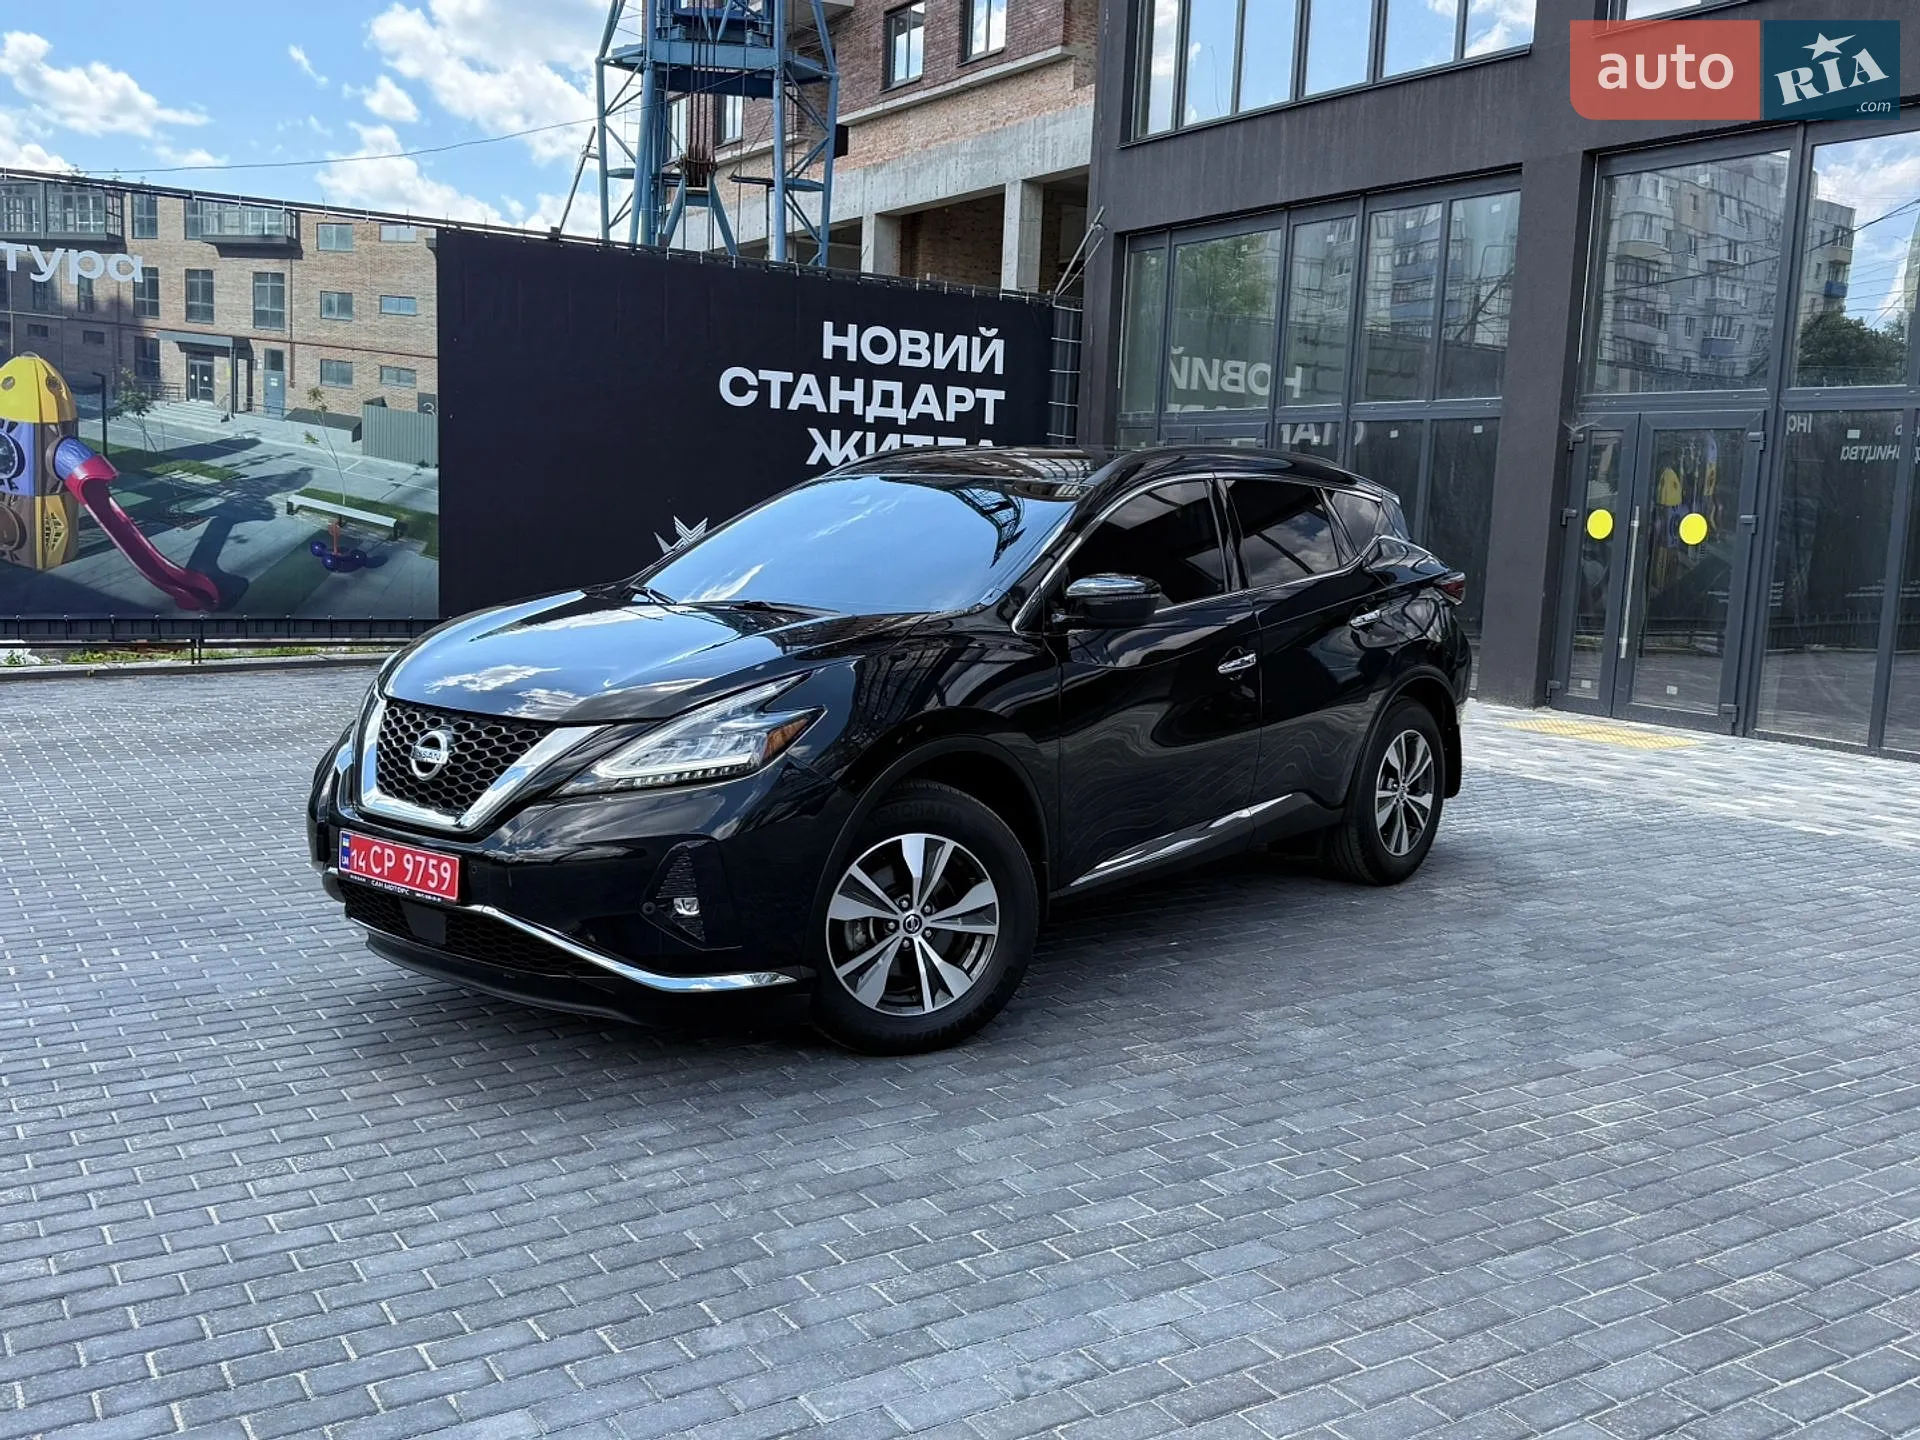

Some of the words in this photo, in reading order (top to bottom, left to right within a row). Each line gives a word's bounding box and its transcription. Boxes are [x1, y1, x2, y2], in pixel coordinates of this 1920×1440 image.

[0, 241, 144, 285] тура
[822, 321, 1004, 375] НОВИЙ
[719, 366, 1006, 425] СТАНДАРТ
[805, 427, 995, 467] ЖИТ
[403, 853, 451, 890] 9759
